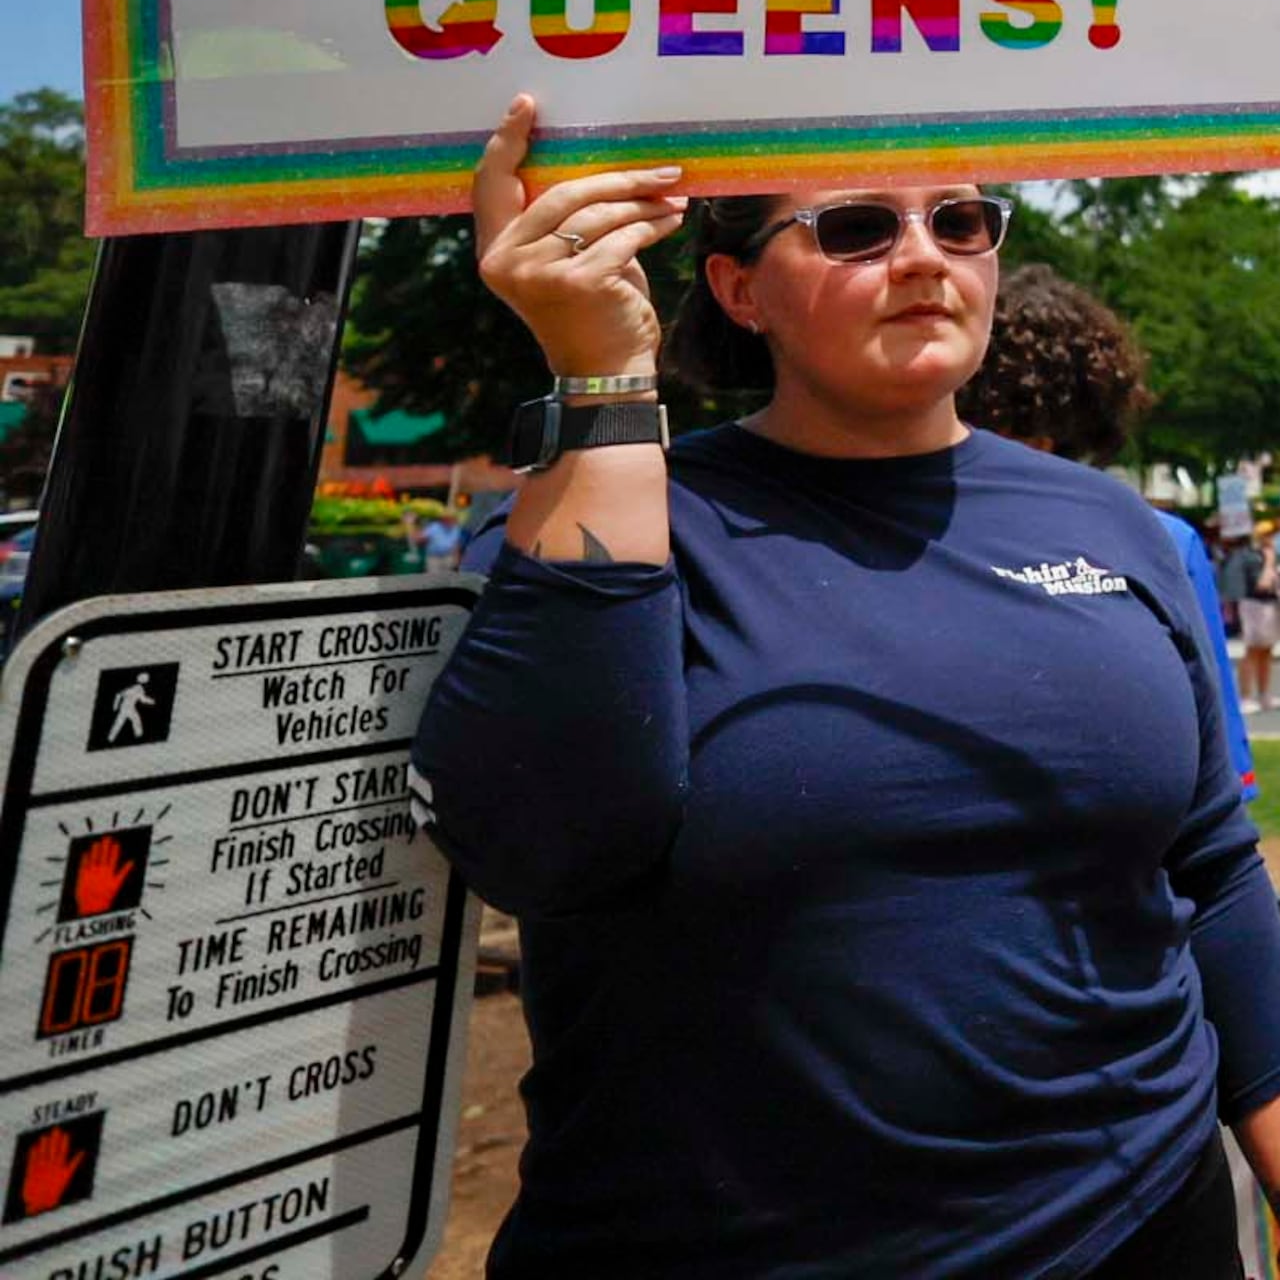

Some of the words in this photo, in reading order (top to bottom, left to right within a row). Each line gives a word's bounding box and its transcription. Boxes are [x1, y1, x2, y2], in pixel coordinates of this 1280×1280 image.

[213, 631, 303, 670] START
[319, 617, 442, 658] CROSSING
[263, 671, 345, 709] Watch
[369, 664, 410, 696] For
[277, 704, 389, 745] Vehicles
[230, 777, 319, 824] DON'T
[332, 764, 409, 805] START
[211, 828, 295, 873] Finish
[315, 808, 418, 852] Crossing
[245, 869, 272, 905] If
[286, 848, 385, 896] Started
[54, 912, 136, 945] FLASHING
[178, 927, 248, 976] TIME
[267, 888, 425, 954] REMAINING
[167, 985, 194, 1020] To
[216, 959, 299, 1009] Finish
[319, 934, 422, 982] Crossing
[51, 1028, 104, 1057] TIMER
[33, 1092, 98, 1124] STEADY
[170, 1075, 272, 1138] DON'T
[288, 1045, 377, 1102] CROSS
[49, 1235, 162, 1280] USH
[182, 1178, 329, 1260] BUTTON
